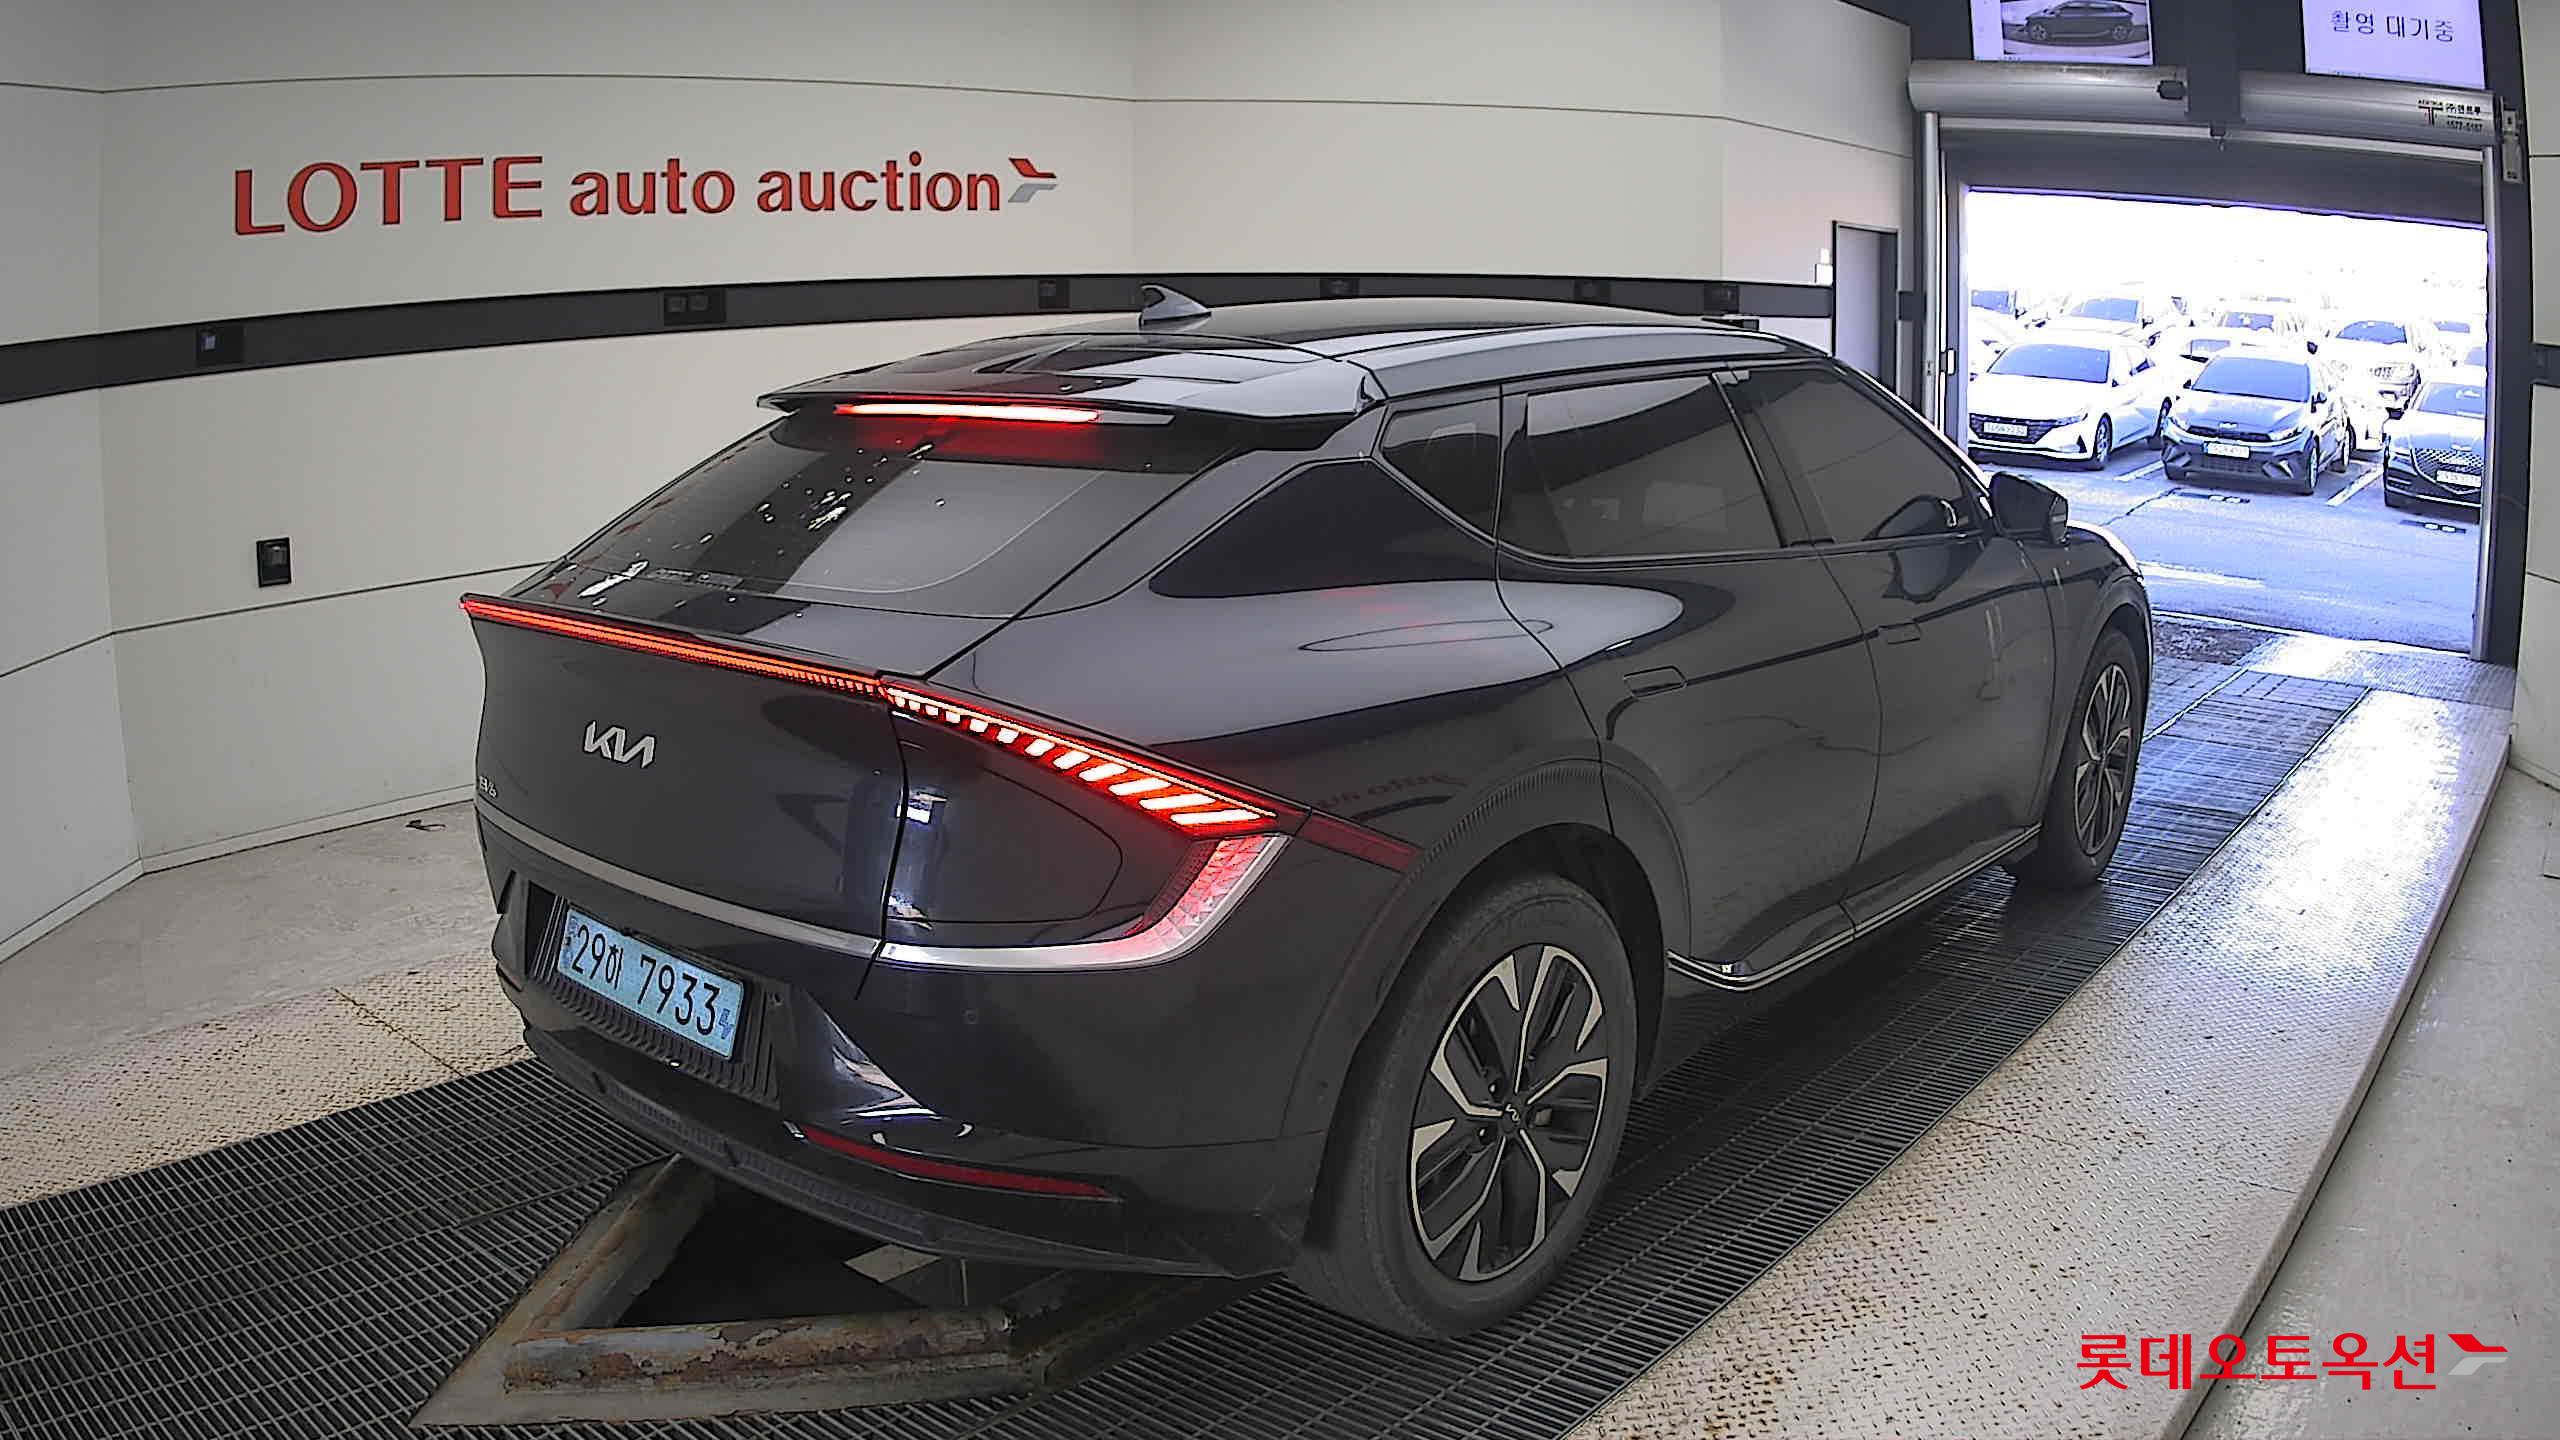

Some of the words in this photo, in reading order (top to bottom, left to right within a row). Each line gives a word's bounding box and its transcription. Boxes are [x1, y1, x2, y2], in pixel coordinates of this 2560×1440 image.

[2332, 10, 2374, 34] 촬영
[2386, 16, 2454, 42] 대기중
[234, 155, 543, 235] LOTTE
[568, 157, 736, 216] auto
[756, 150, 1001, 213] auction
[636, 954, 721, 1036] 7933
